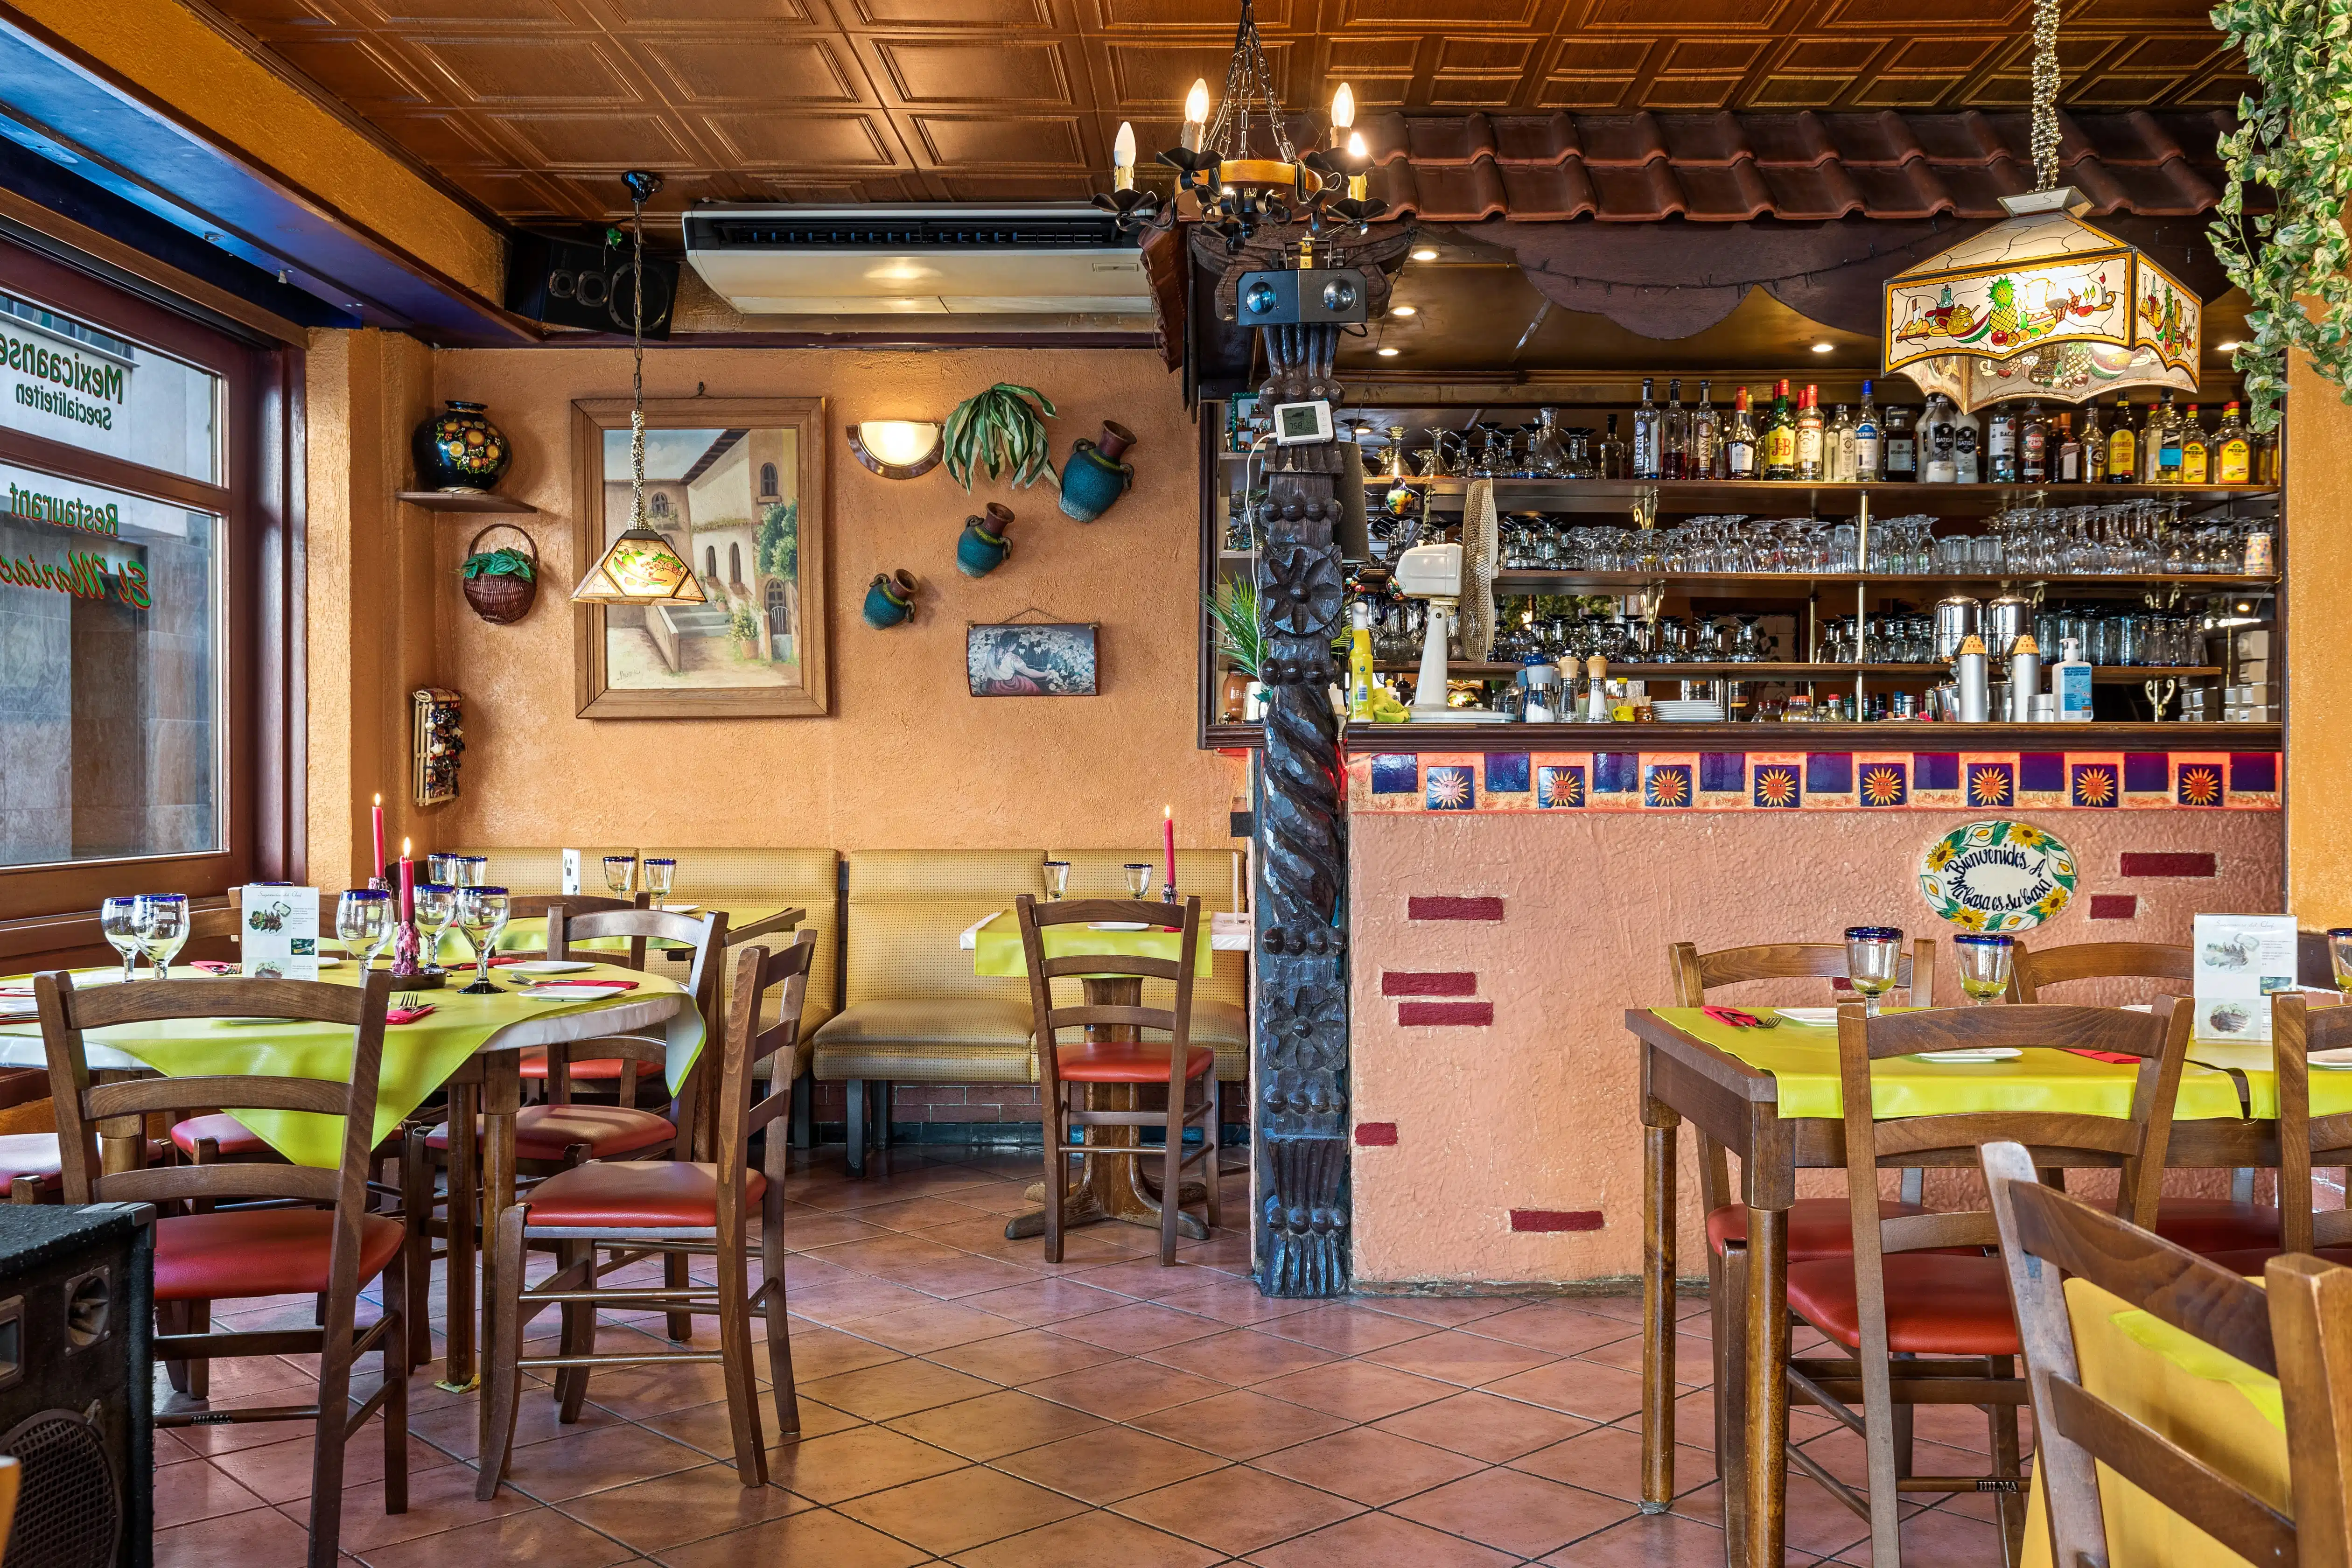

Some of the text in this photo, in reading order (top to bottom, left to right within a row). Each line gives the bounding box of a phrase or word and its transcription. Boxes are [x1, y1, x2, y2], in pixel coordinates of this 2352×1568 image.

[1701, 438, 1710, 466] FUNNY
[1771, 438, 1791, 456] J&B
[2093, 452, 2104, 461] 43
[1945, 843, 2046, 877] Bienvenidos A
[1947, 875, 1968, 899] Mi
[1963, 887, 1991, 910] Casa
[1992, 896, 2005, 912] es
[2020, 878, 2053, 905] Casa
[1979, 1482, 2017, 1490] HILMA
